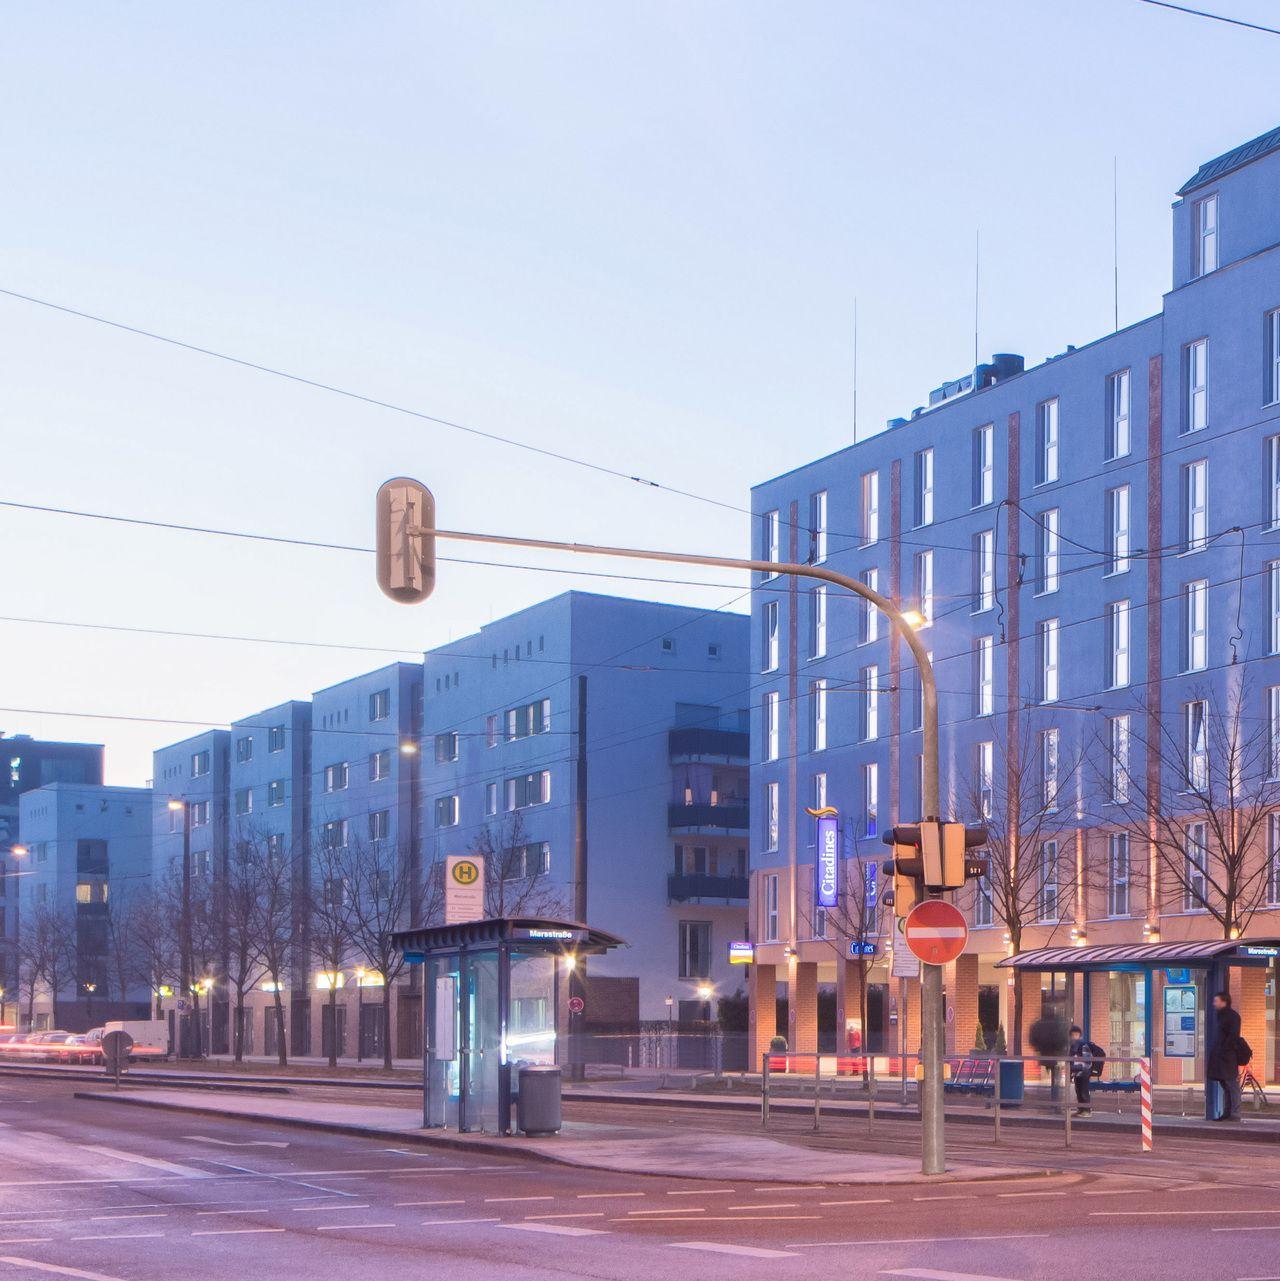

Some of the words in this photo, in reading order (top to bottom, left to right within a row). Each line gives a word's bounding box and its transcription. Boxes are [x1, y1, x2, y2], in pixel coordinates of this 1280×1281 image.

[820, 830, 835, 895] Citadines
[459, 866, 472, 879] H
[529, 930, 573, 939] Marsstraße
